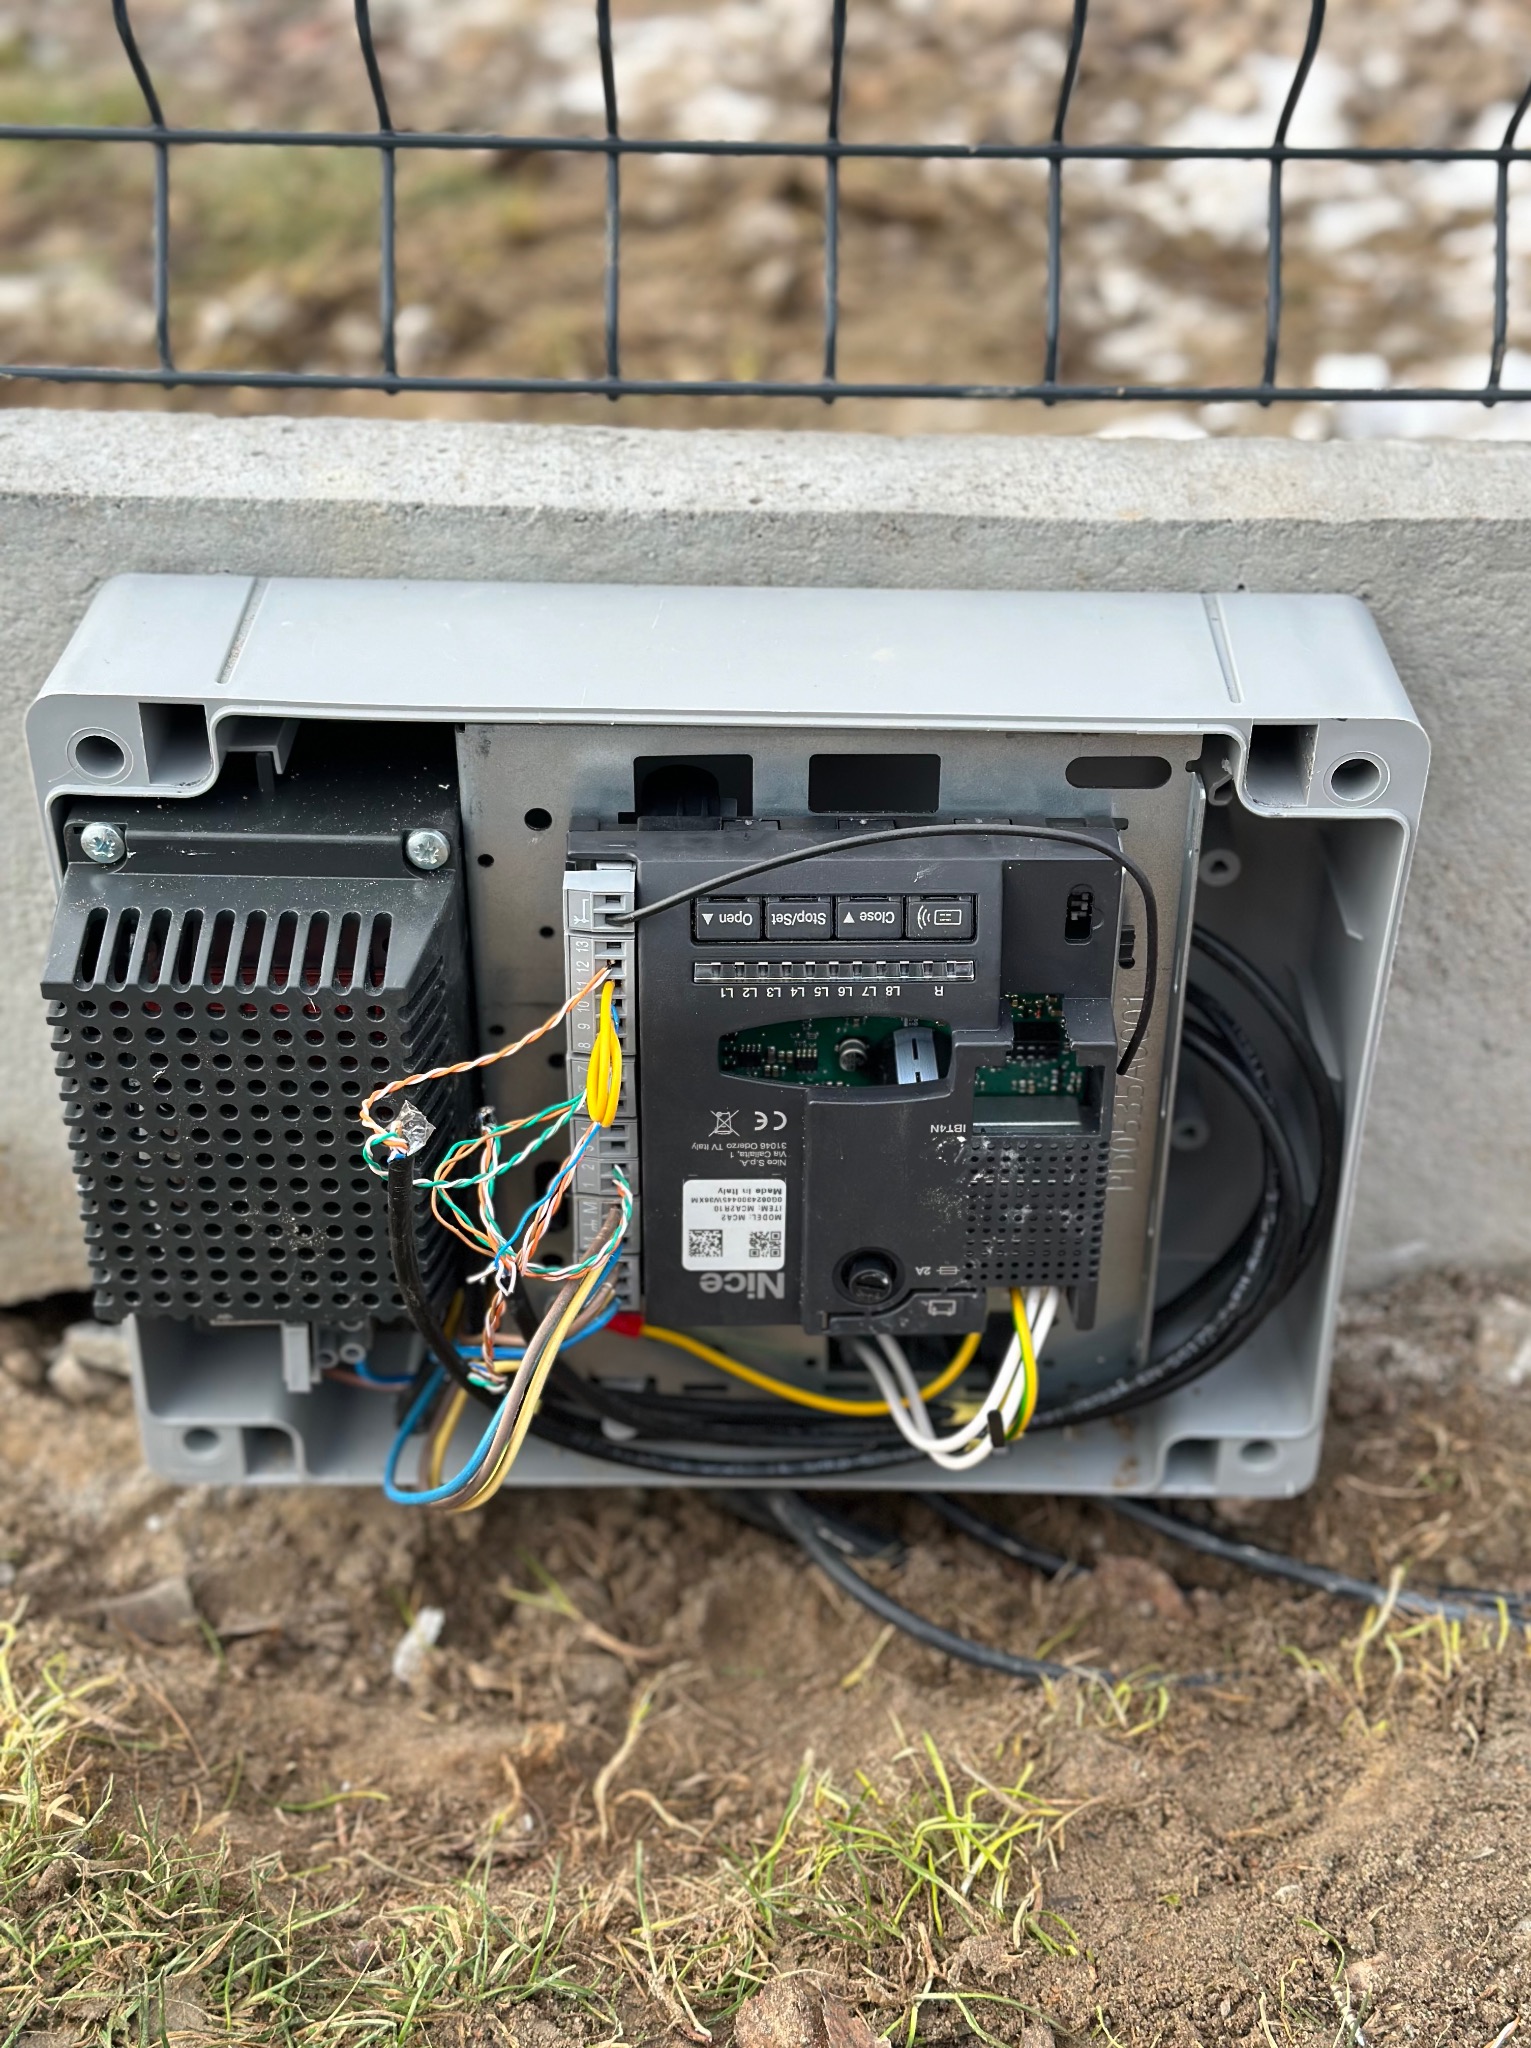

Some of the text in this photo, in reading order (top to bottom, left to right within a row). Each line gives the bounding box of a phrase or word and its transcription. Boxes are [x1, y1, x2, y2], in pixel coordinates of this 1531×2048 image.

[719, 913, 753, 926] Open
[771, 912, 827, 926] Stop/Set
[859, 911, 896, 924] Close
[576, 941, 589, 953] 13
[576, 960, 590, 972] 12
[720, 986, 944, 998] R L8 L7 L6 L5 L4 L3 L2 L1
[577, 1001, 590, 1012] 10
[930, 1124, 967, 1133] IBT4N
[691, 1142, 710, 1150] Italy
[711, 1142, 724, 1150] TV
[726, 1142, 759, 1150] Oderzo
[773, 1150, 788, 1158] Via
[582, 1163, 595, 1171] 2
[739, 1159, 765, 1167] S.p.A.
[717, 1187, 738, 1196] Italy
[755, 1187, 783, 1195] Made
[582, 1202, 598, 1214] M
[713, 1204, 782, 1212] ITEM: MCA2R10
[721, 1213, 782, 1221] MODEL: MCA2
[915, 1266, 932, 1275] 2A
[699, 1271, 785, 1300] Nice
